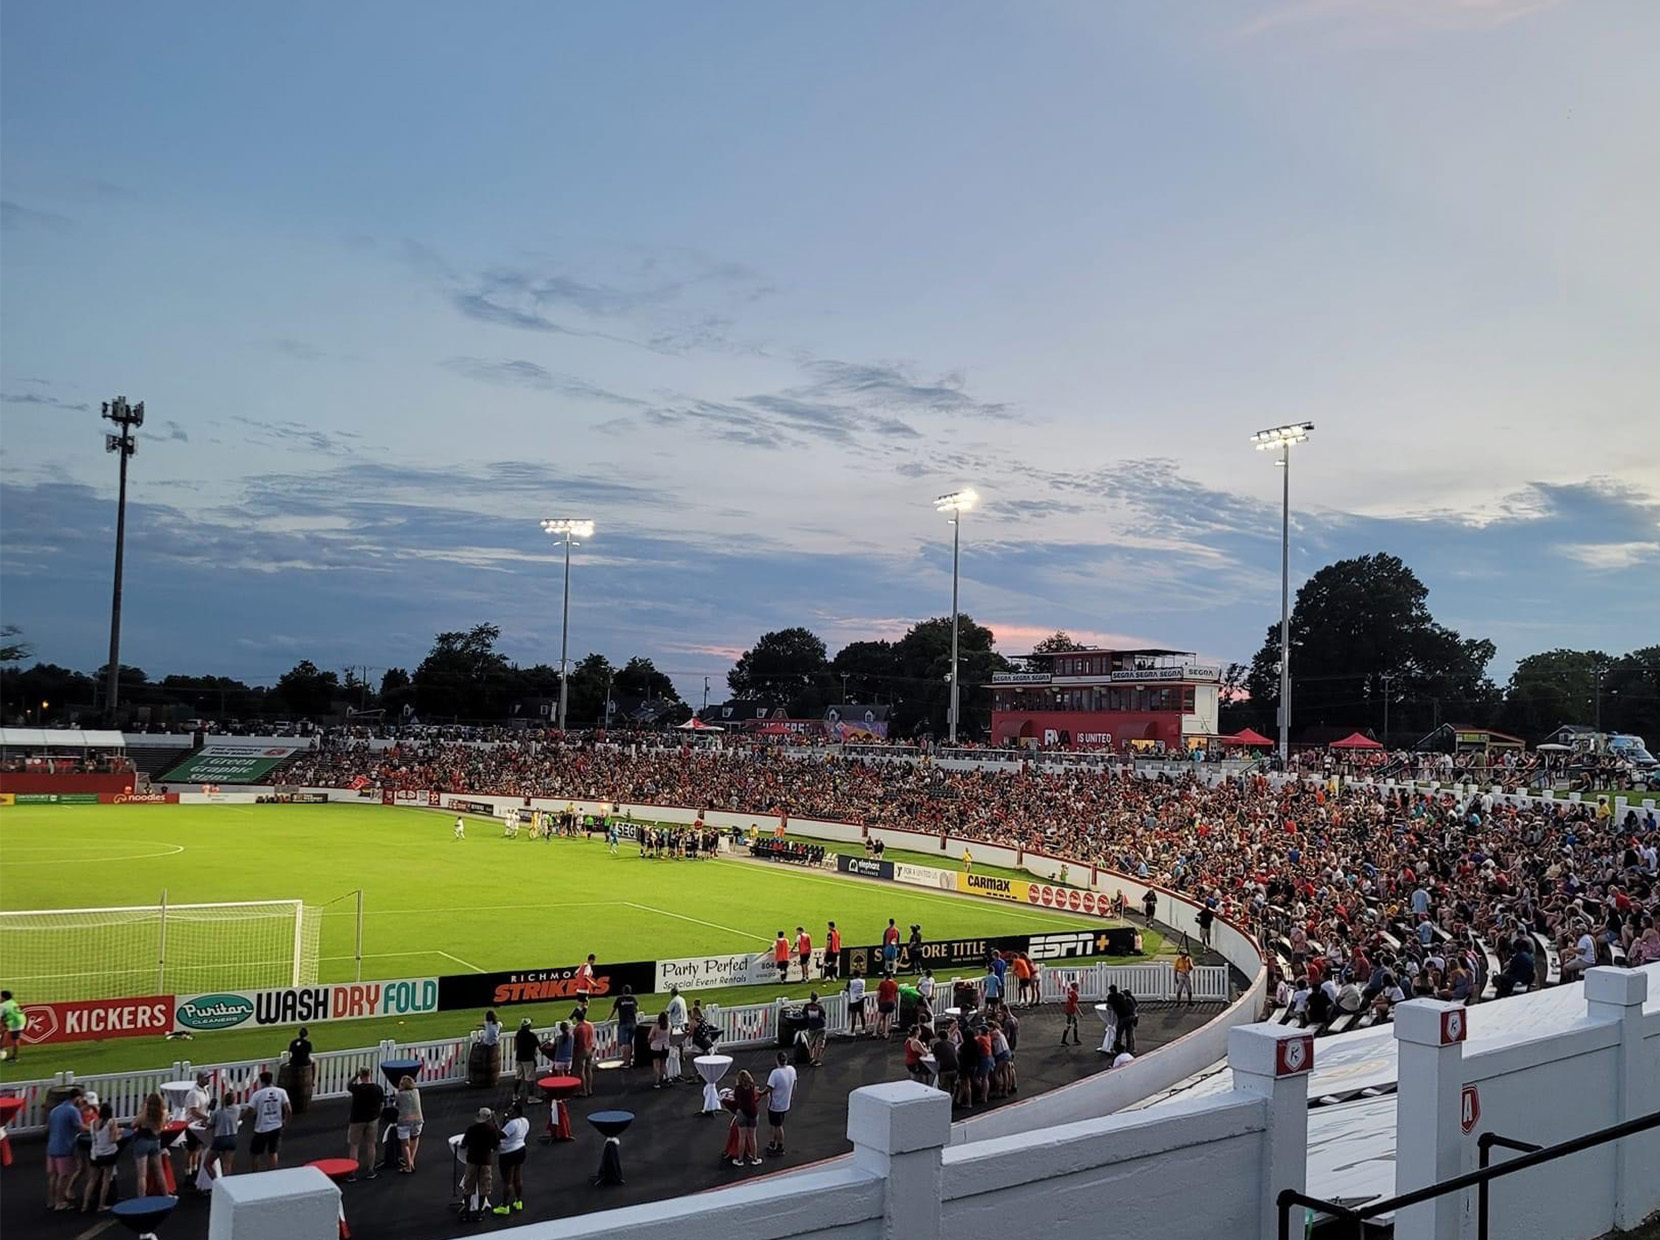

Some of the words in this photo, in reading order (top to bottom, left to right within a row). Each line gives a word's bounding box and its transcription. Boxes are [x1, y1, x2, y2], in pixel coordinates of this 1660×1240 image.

[1113, 671, 1134, 679] SEGRA
[1160, 669, 1181, 677] SEGRA
[1189, 669, 1213, 677] SEGRA
[1077, 732, 1084, 743] IS
[1085, 733, 1111, 744] UNITED
[190, 765, 253, 774] Graphic
[128, 793, 166, 801] noodles
[858, 859, 880, 870] elephant
[951, 941, 986, 956] TITLE
[661, 962, 699, 978] Party
[704, 957, 748, 976] Perfect
[663, 979, 694, 990] Special
[695, 978, 717, 987] Event
[719, 974, 747, 984] Rentals
[256, 988, 329, 1025] WASH
[332, 983, 381, 1018] DRY
[383, 980, 437, 1014] FOLD
[182, 1002, 253, 1018] Puritan
[65, 1004, 167, 1034] KICKERS
[192, 1016, 238, 1025] CLEANERS
